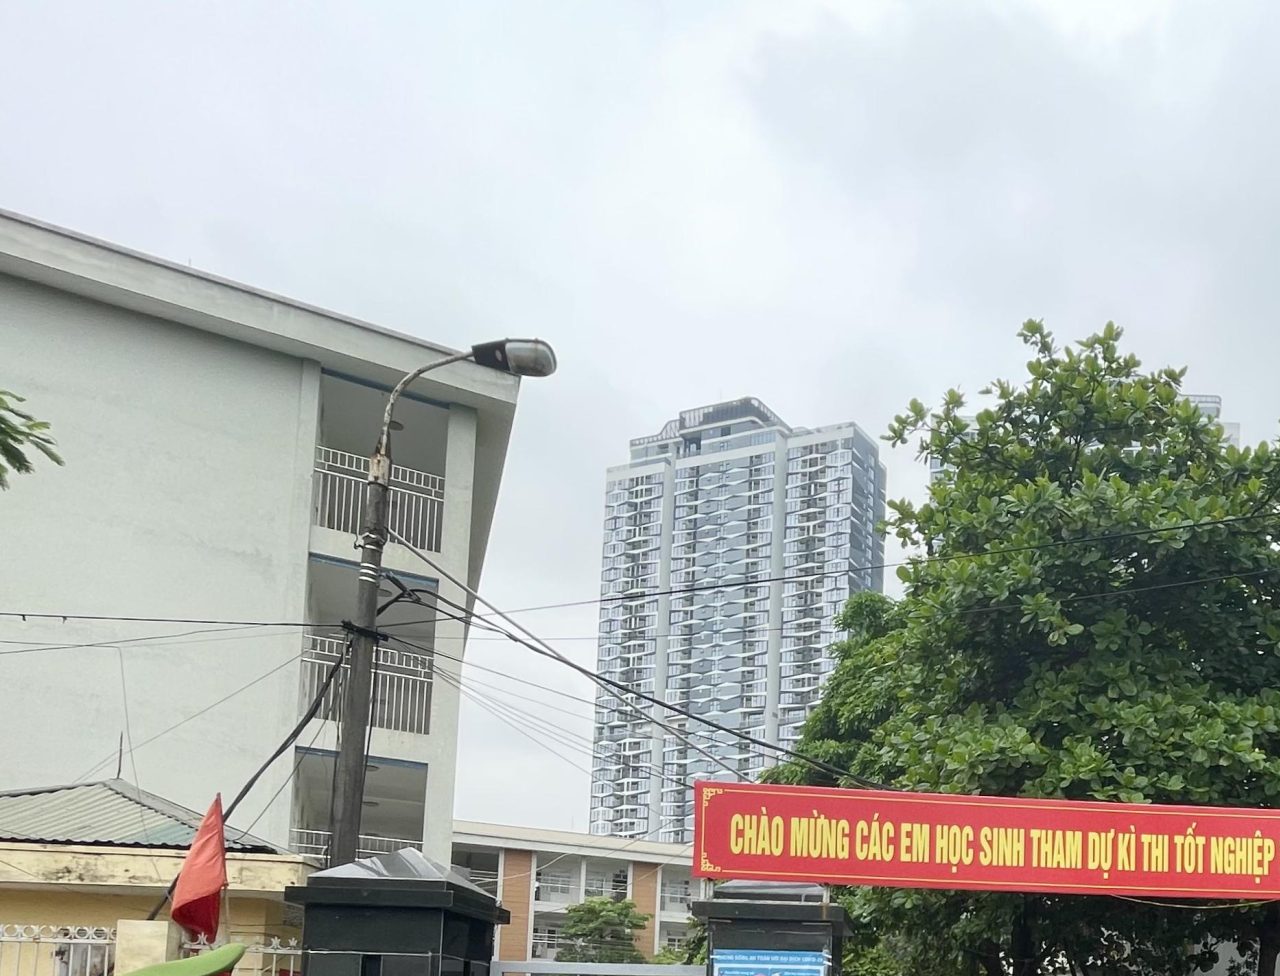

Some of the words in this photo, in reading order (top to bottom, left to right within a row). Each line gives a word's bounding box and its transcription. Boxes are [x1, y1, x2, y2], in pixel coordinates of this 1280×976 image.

[730, 807, 784, 856] CHÀO
[790, 810, 850, 859] MỪNG
[855, 813, 895, 862] CÁC
[900, 823, 930, 863] EM
[935, 824, 974, 873] HỌC
[979, 826, 1025, 867] SINH
[1030, 829, 1082, 869] THAM
[1088, 828, 1115, 879] DỰ
[1118, 825, 1136, 871] KÌ
[1141, 834, 1169, 872] THI
[1174, 822, 1205, 874] TỐT
[1210, 830, 1275, 884] NGHIỆP
